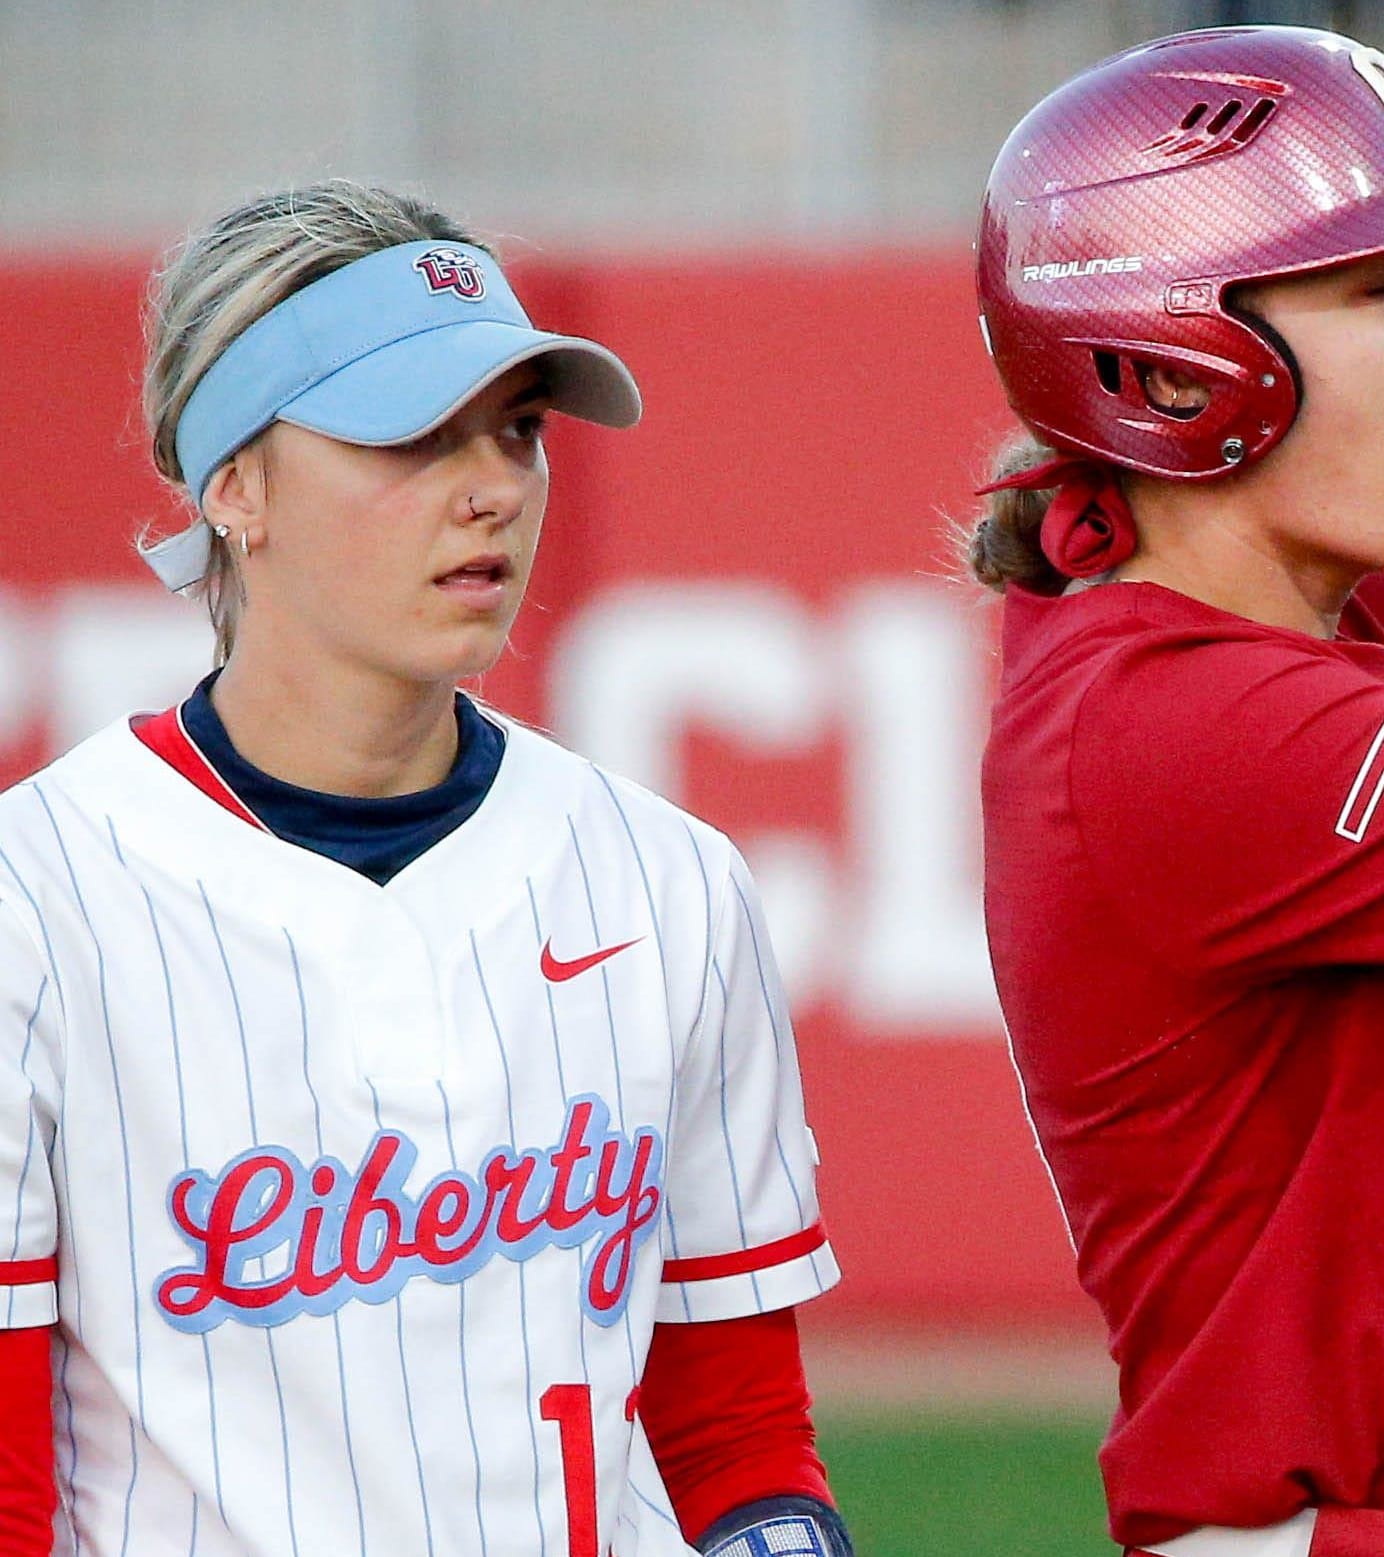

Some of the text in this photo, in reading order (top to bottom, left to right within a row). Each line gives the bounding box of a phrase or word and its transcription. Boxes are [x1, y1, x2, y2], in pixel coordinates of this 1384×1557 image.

[413, 257, 487, 302] LU
[1023, 256, 1143, 283] RAWLINGS
[156, 1099, 660, 1313] Liberty
